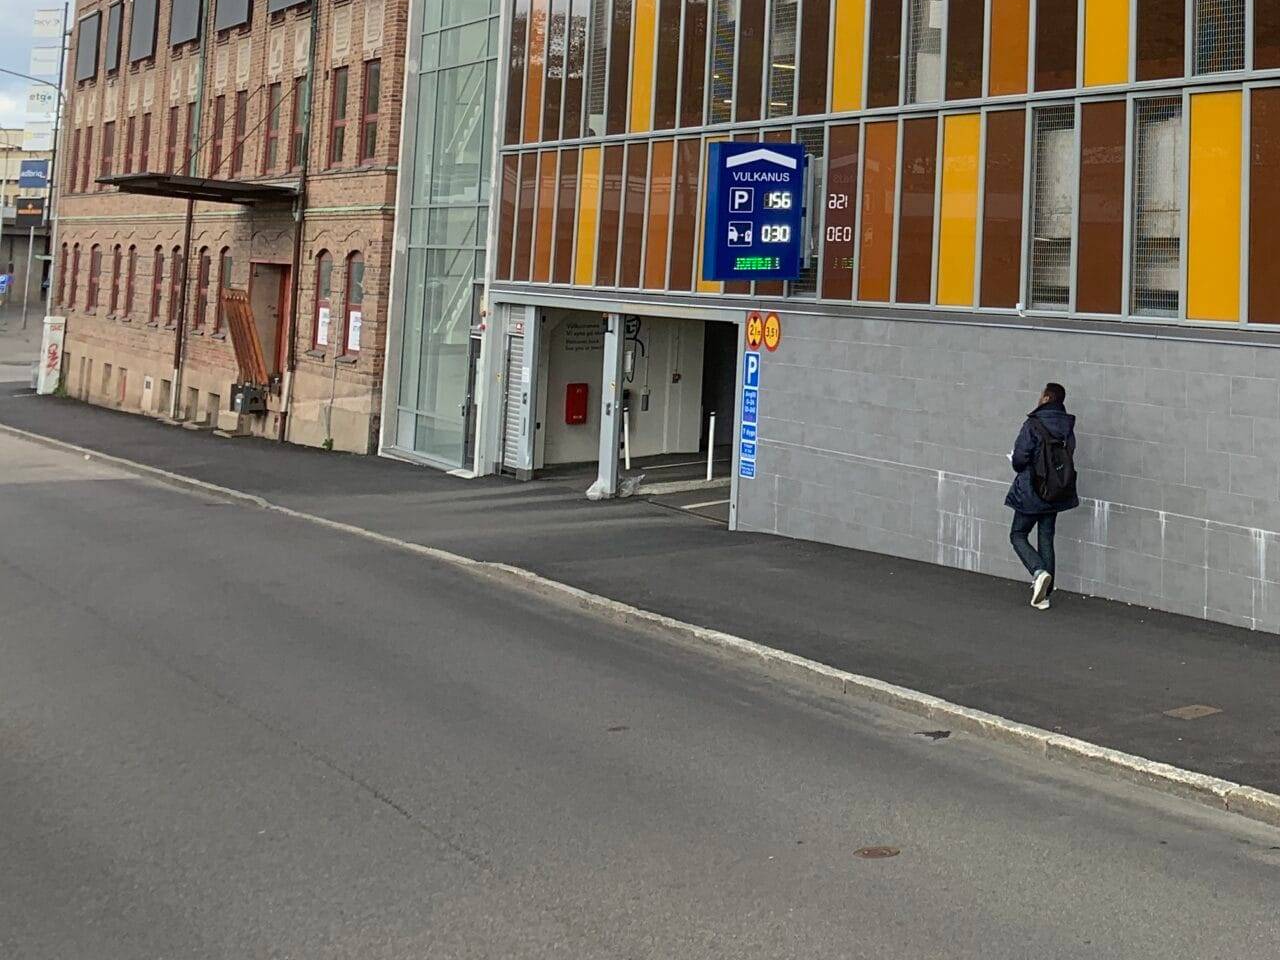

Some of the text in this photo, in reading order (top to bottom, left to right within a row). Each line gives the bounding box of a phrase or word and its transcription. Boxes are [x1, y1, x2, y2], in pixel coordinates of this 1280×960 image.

[733, 172, 790, 182] VULKANUS
[734, 191, 749, 210] P
[768, 192, 791, 209] 156
[761, 225, 790, 242] 030
[747, 355, 758, 385] P
